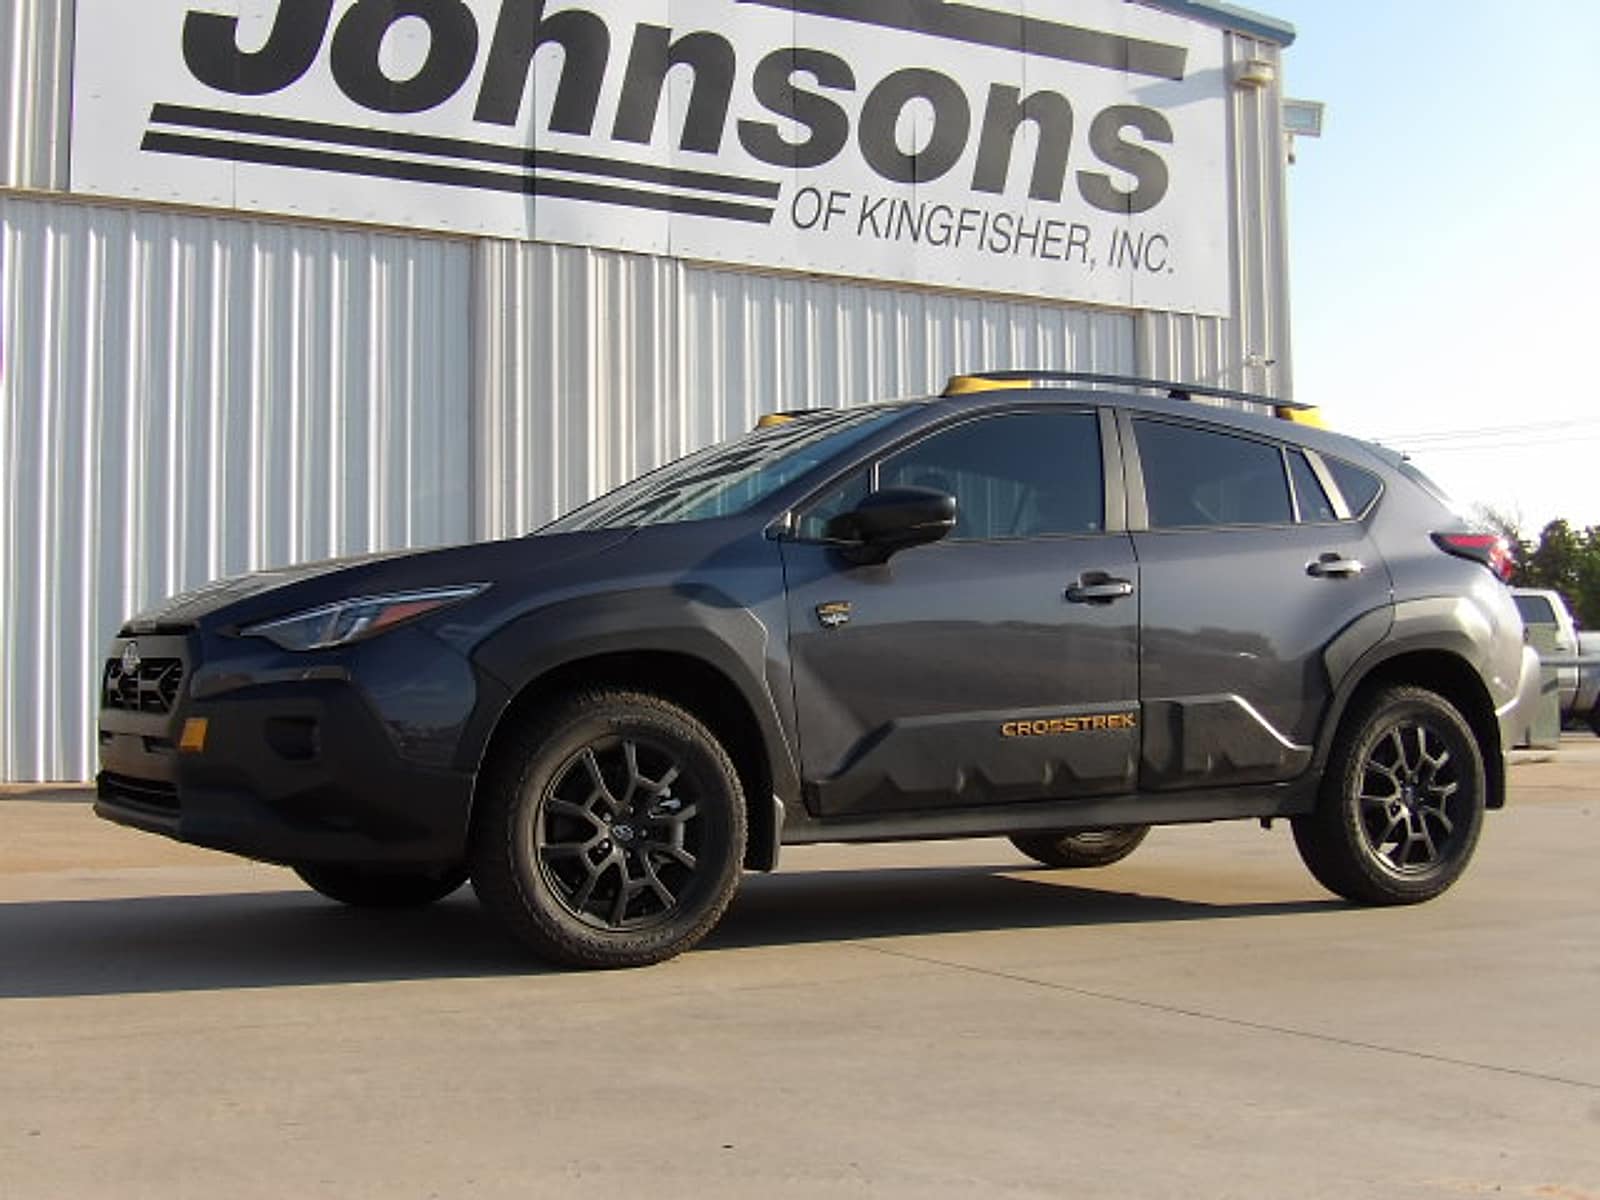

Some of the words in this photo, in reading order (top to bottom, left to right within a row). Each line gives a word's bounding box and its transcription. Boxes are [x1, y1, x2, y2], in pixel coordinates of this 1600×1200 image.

[791, 187, 851, 231] OF
[857, 195, 1096, 270] KINGFISHER,
[1108, 229, 1174, 274] INC.
[1001, 712, 1137, 737] CROSSTREK
